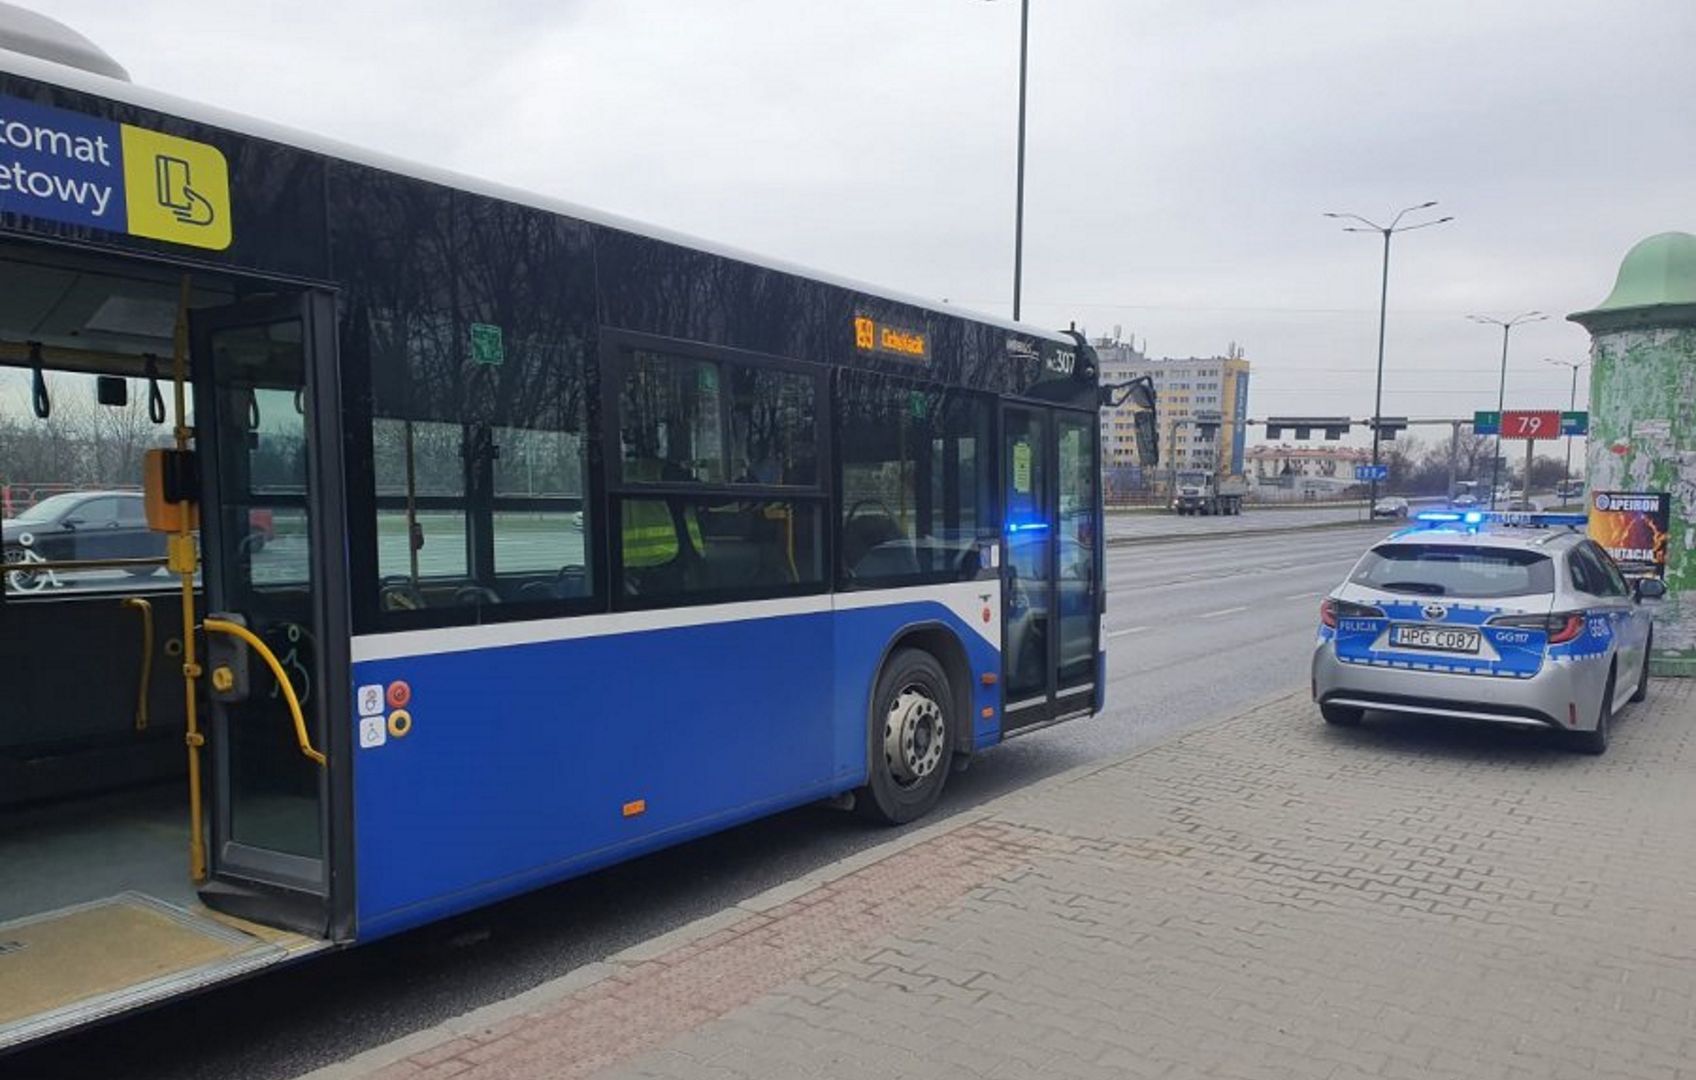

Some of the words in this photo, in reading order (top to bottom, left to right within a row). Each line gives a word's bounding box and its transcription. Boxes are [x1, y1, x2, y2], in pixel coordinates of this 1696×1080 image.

[0, 119, 110, 167] omat
[1518, 416, 1542, 434] 79
[1609, 499, 1660, 511] APEIRON
[1339, 620, 1377, 632] POLICJA
[1399, 630, 1430, 645] HPG
